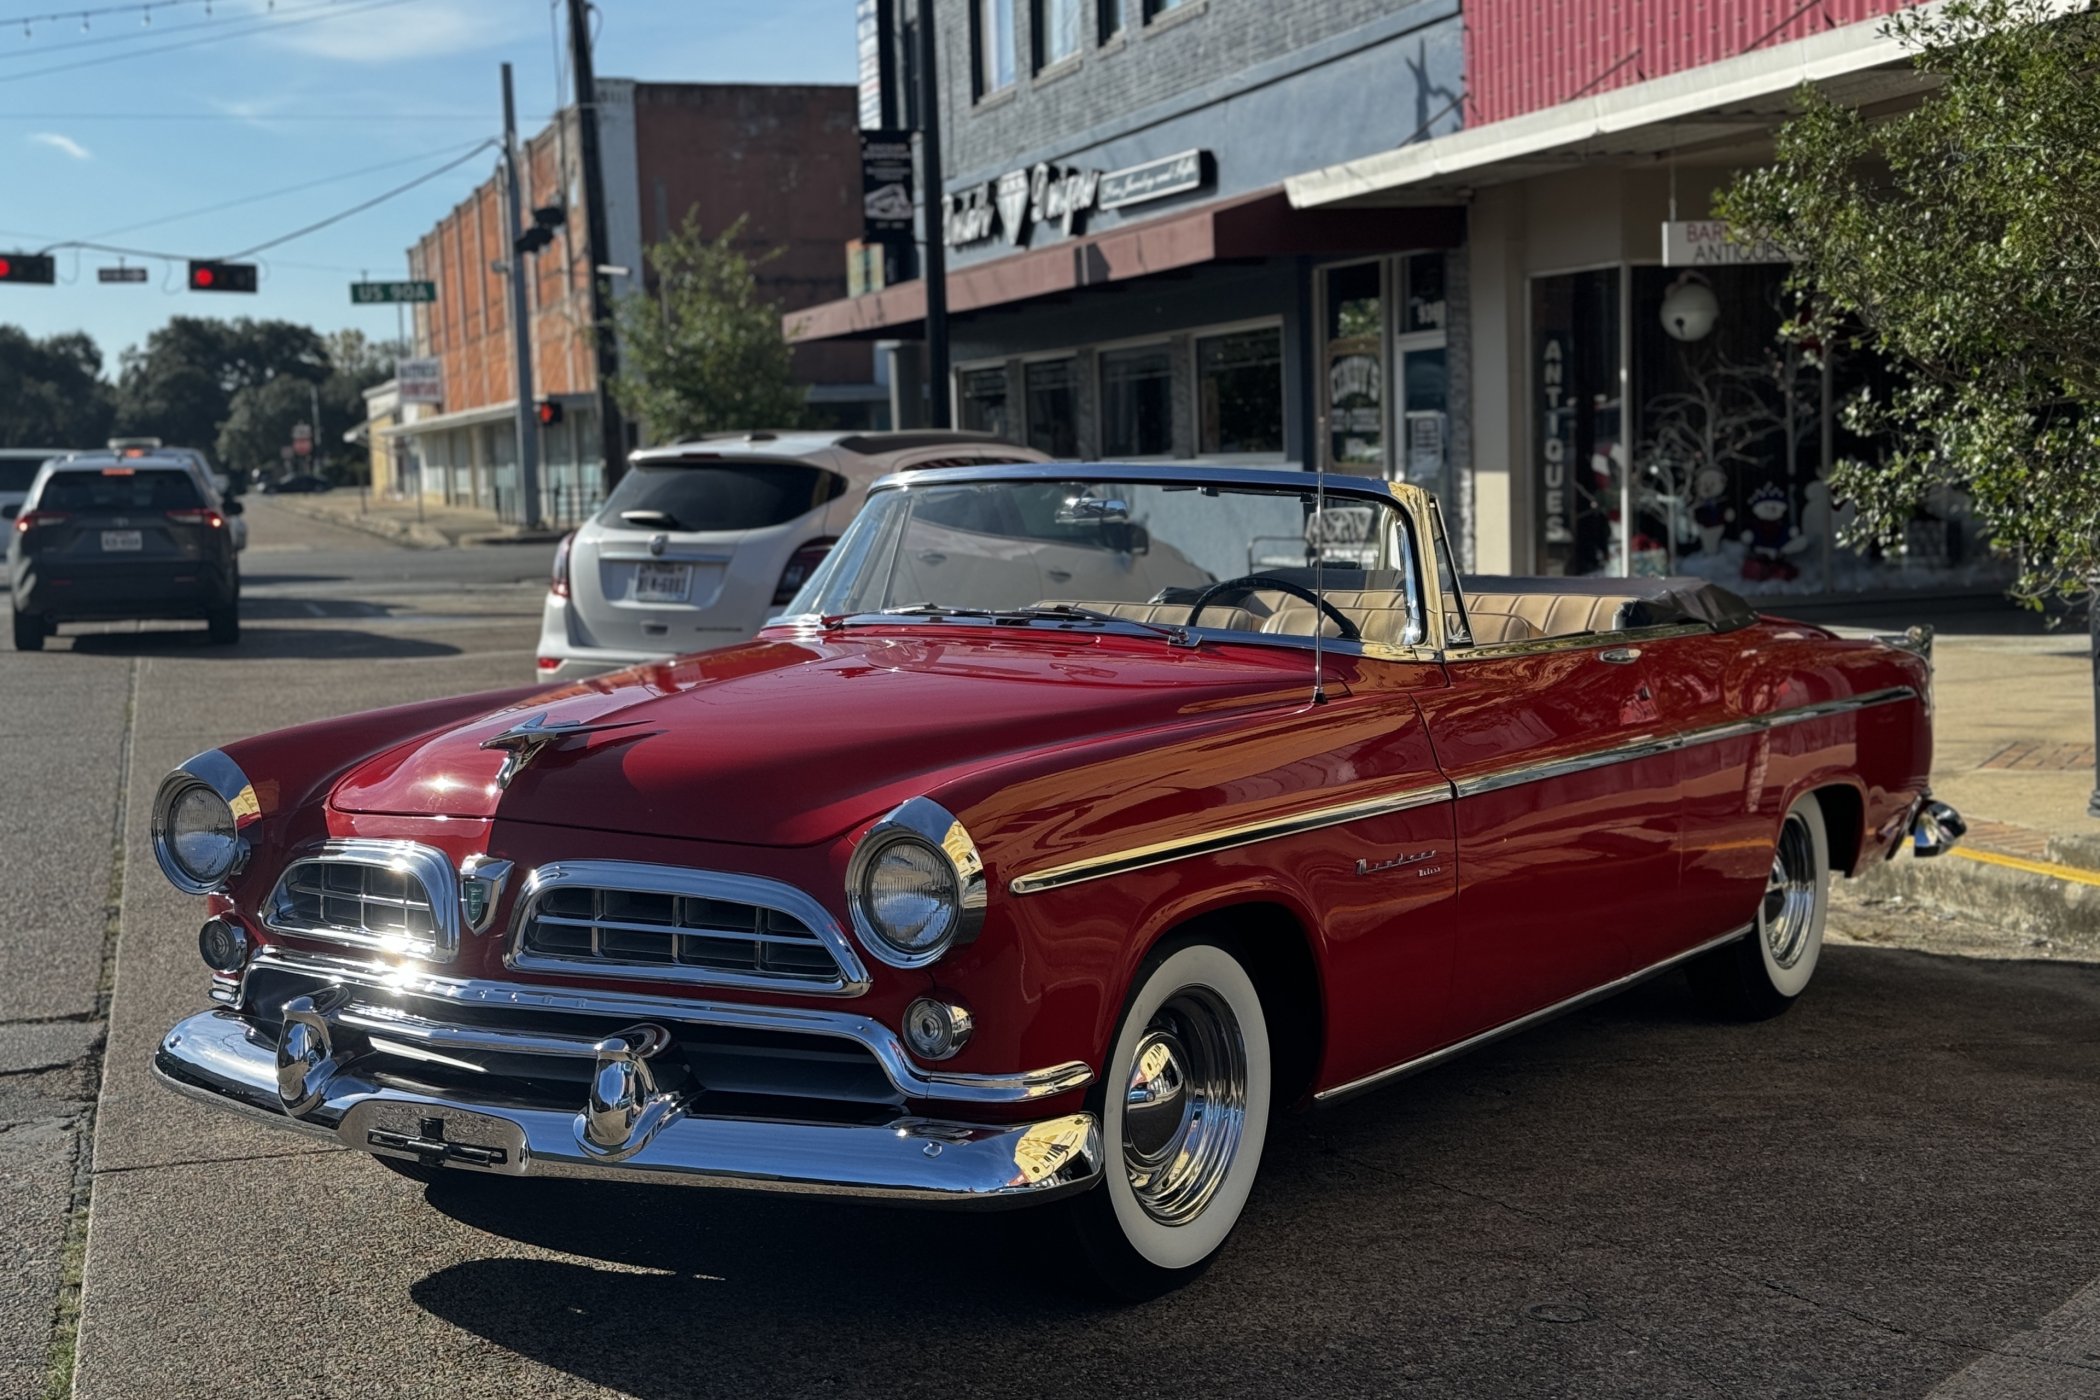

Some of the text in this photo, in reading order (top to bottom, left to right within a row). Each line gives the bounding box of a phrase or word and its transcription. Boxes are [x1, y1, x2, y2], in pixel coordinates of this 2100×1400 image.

[358, 283, 429, 301] US 90A
[1544, 339, 1565, 541] ANTIQUES
